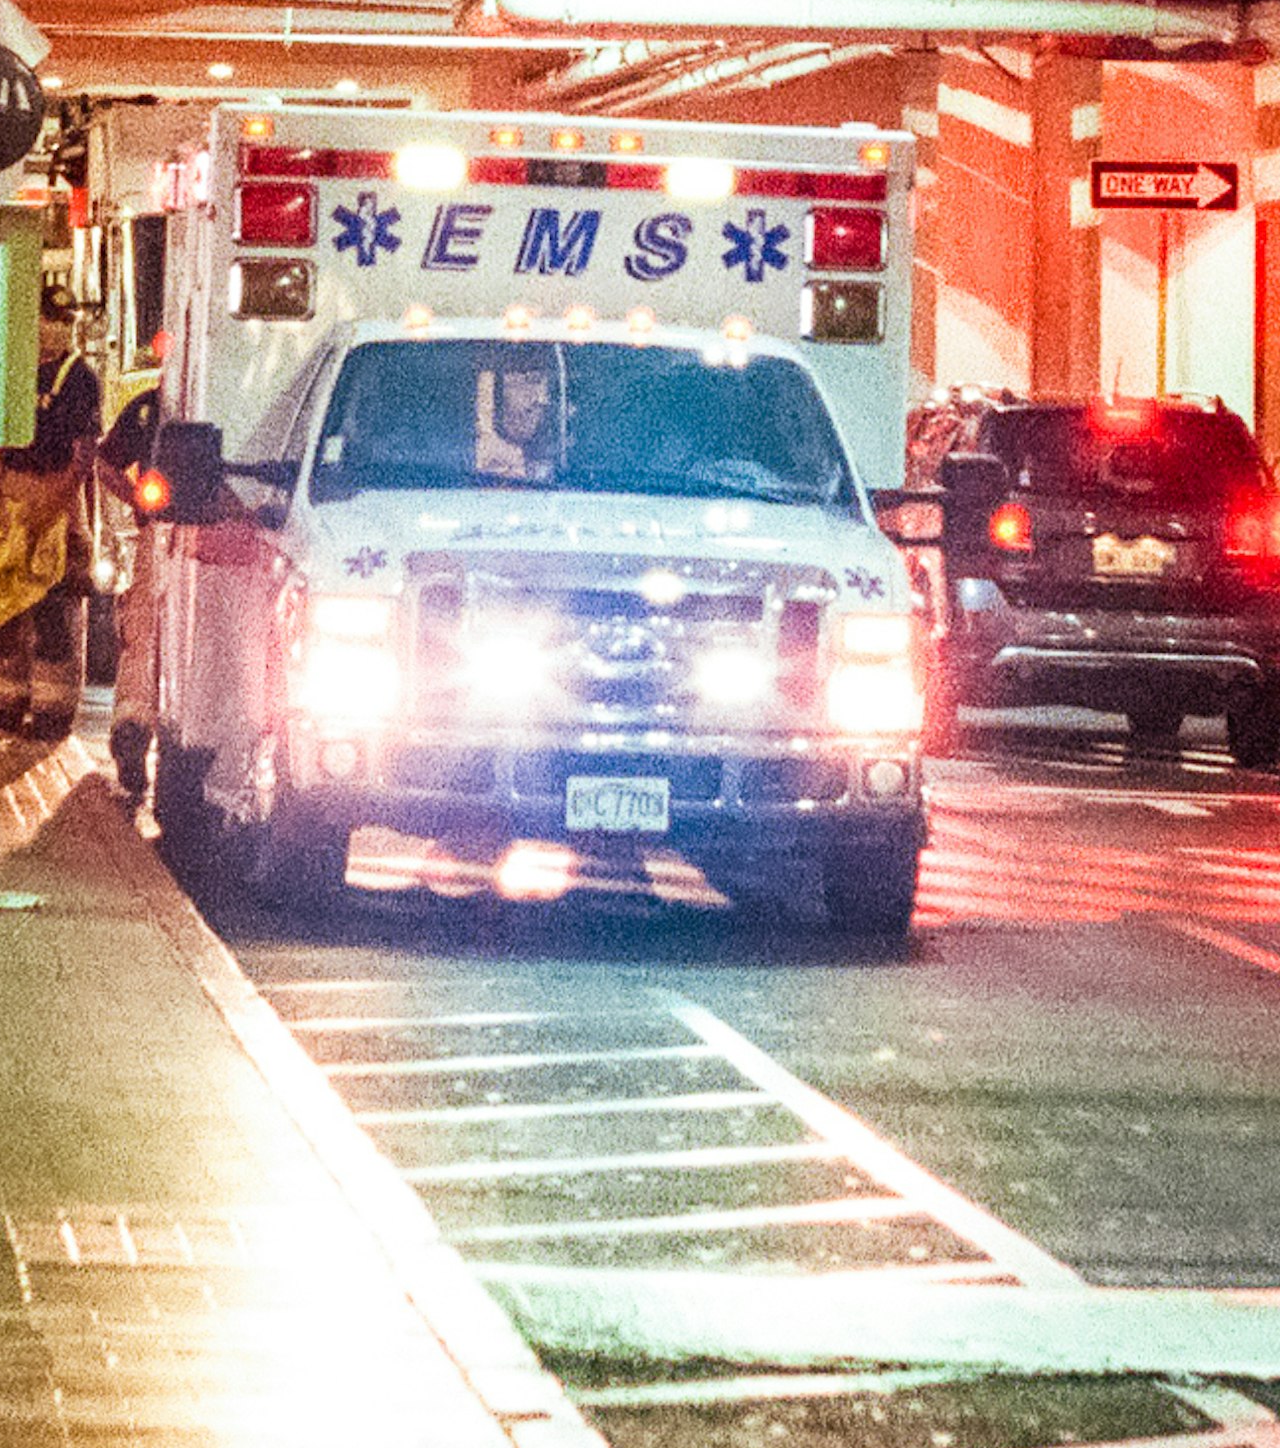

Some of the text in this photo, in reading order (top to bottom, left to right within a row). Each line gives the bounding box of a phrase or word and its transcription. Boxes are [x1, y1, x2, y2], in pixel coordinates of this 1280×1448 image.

[1106, 175, 1195, 195] ONE WAY
[420, 204, 693, 282] EMS
